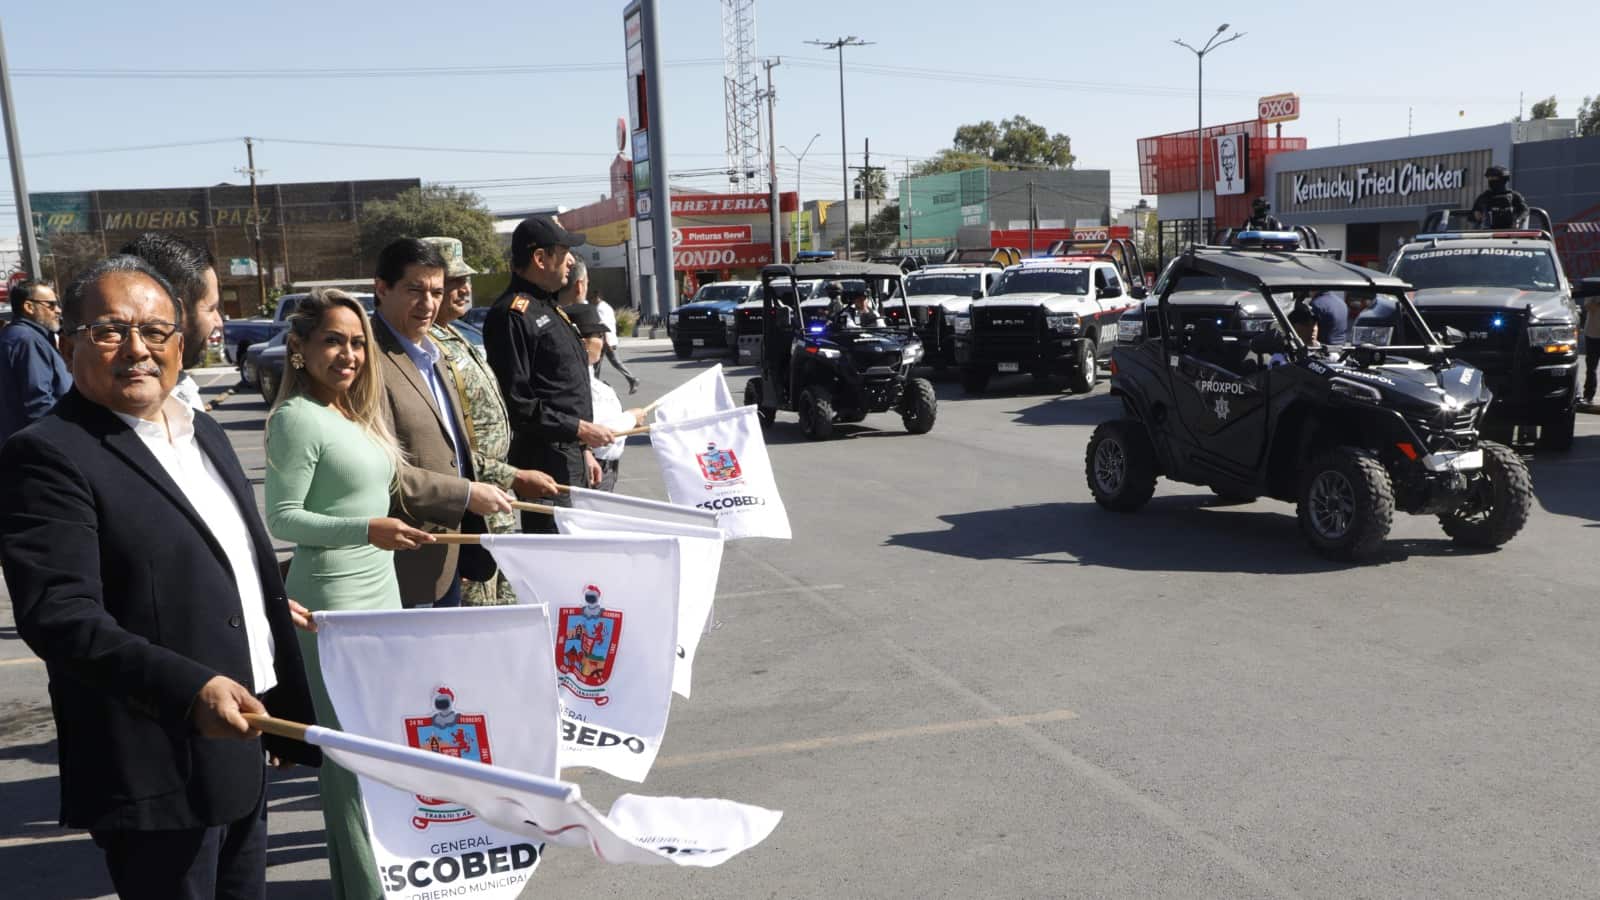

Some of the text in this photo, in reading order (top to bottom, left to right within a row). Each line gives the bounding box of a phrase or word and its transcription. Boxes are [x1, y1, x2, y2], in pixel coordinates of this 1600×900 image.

[1259, 99, 1294, 118] OXXO
[1293, 163, 1462, 203] Kentucky Fried Chicken
[105, 210, 200, 230] MADERAS
[688, 231, 722, 240] Pinturas
[898, 247, 945, 256] PROYECTOS
[1201, 380, 1245, 394] PROXPOL
[430, 834, 494, 854] GENERAL
[381, 843, 546, 883] SCOBED
